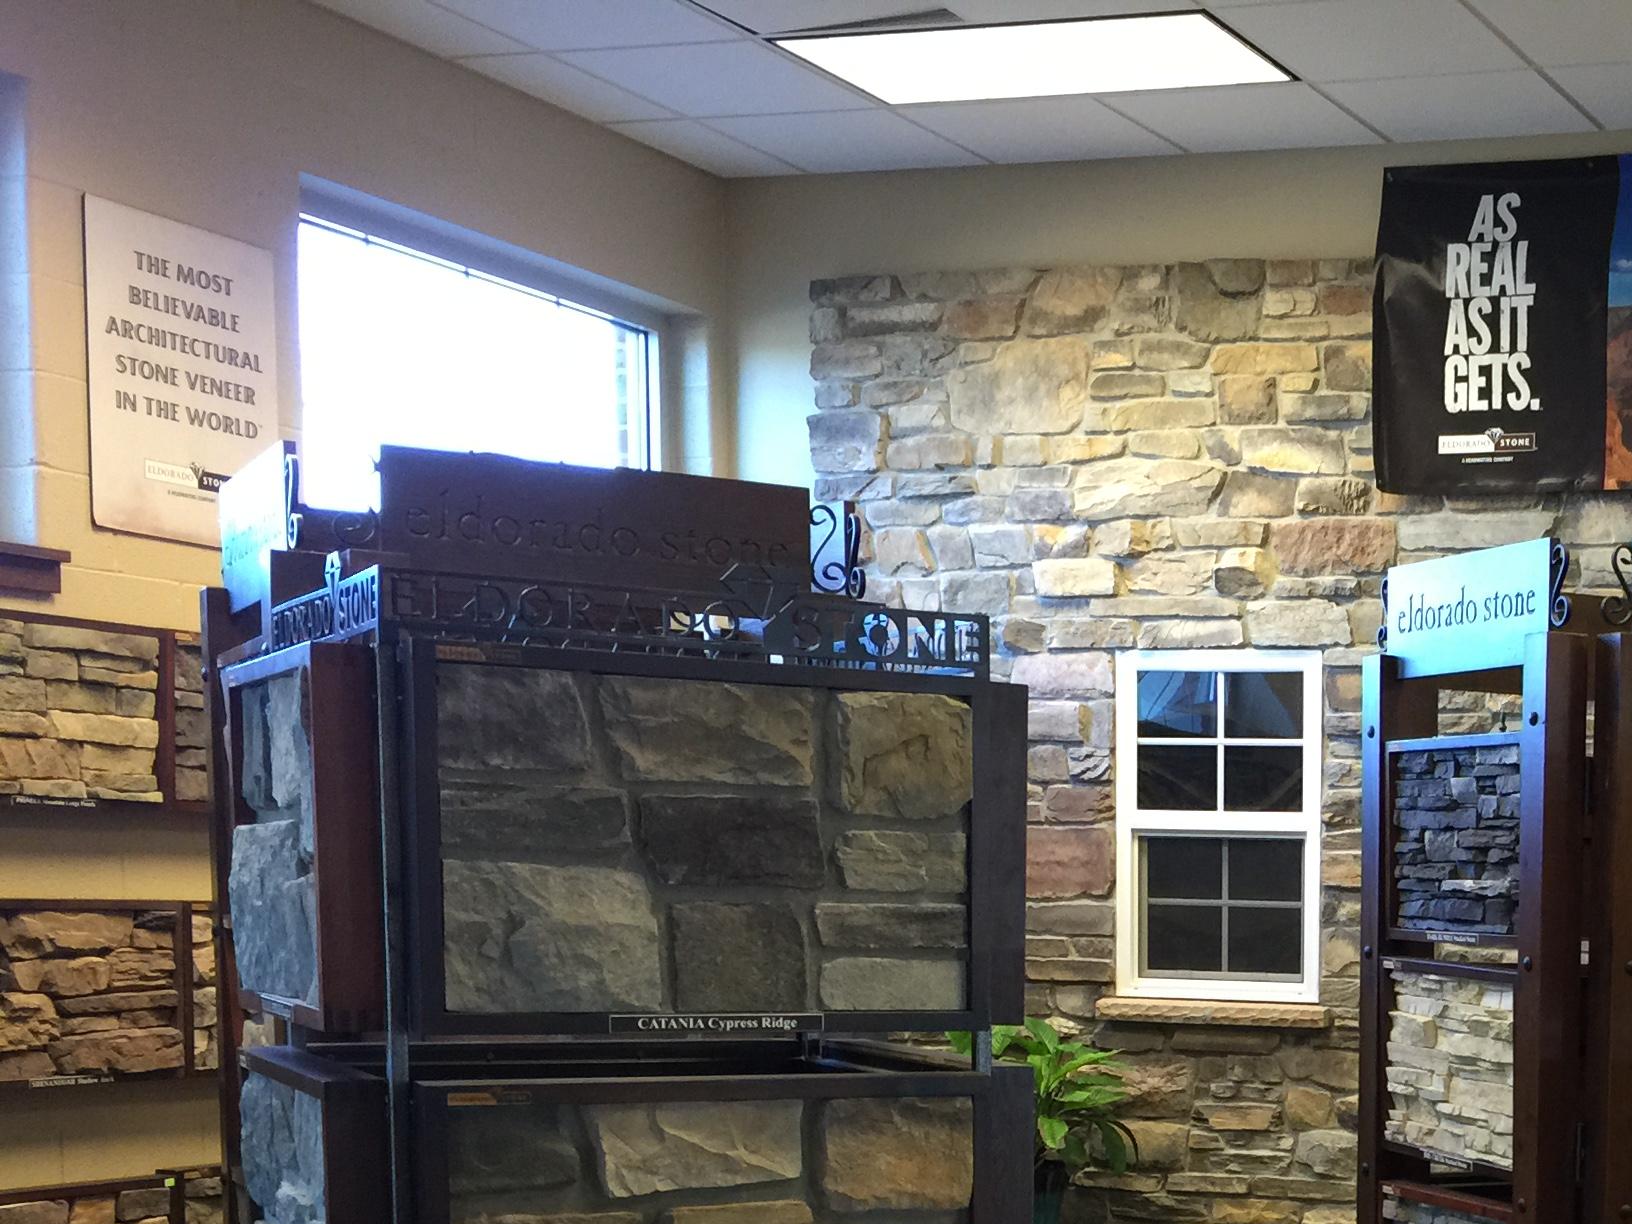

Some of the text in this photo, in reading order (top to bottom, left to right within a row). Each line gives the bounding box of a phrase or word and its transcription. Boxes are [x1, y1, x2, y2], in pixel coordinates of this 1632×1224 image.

[1468, 192, 1521, 243] AS
[134, 250, 234, 297] THE MOST
[1445, 240, 1536, 299] REAL
[128, 285, 241, 333] BELIEVABLE
[1444, 295, 1534, 356] AS IT
[105, 316, 263, 373] ARCHITECTURAL
[115, 354, 257, 406] STONE VENEER
[1444, 353, 1541, 414] GETS.
[115, 389, 259, 439] IN THE WORLD
[1499, 437, 1531, 447] STONE
[406, 489, 790, 570] eldorado stone
[272, 574, 378, 650] ELDORADO STONE
[390, 570, 982, 664] ELDORADO STONE
[1398, 585, 1537, 633] eldorado stone
[637, 1016, 798, 1031] CATANIA Cypress Ridge
